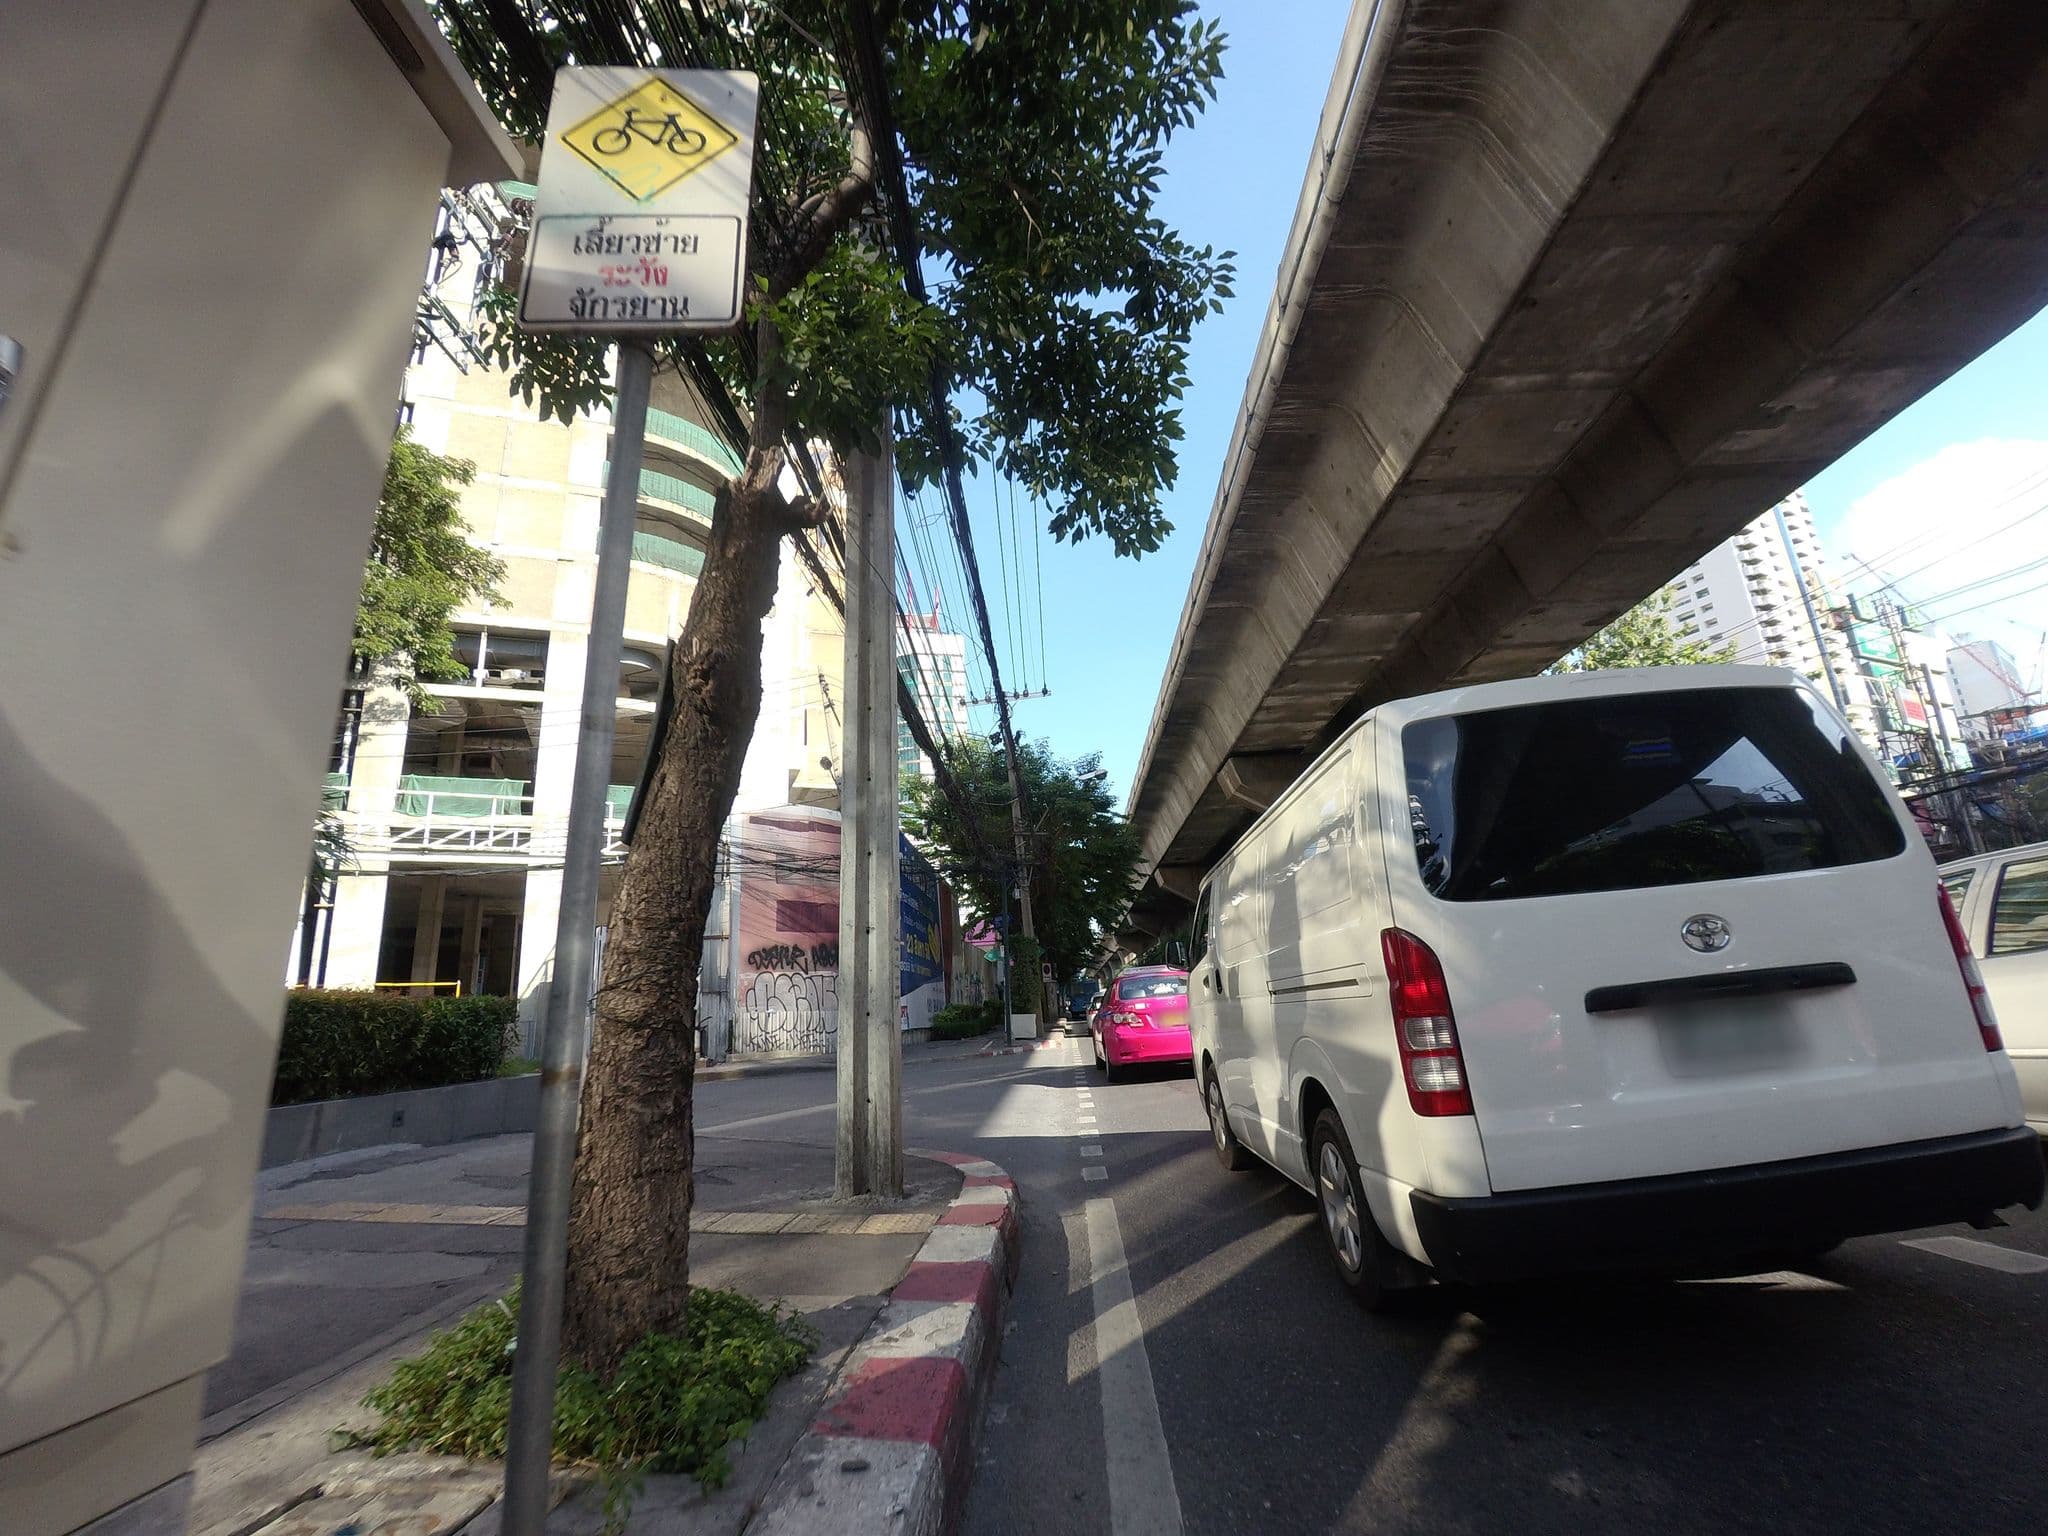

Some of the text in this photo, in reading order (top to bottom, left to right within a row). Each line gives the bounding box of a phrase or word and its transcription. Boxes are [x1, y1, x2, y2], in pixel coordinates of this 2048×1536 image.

[573, 216, 699, 255] เลี้ยวซ้าย
[599, 256, 669, 288] ระวัง
[569, 286, 690, 318] จักรยาน
